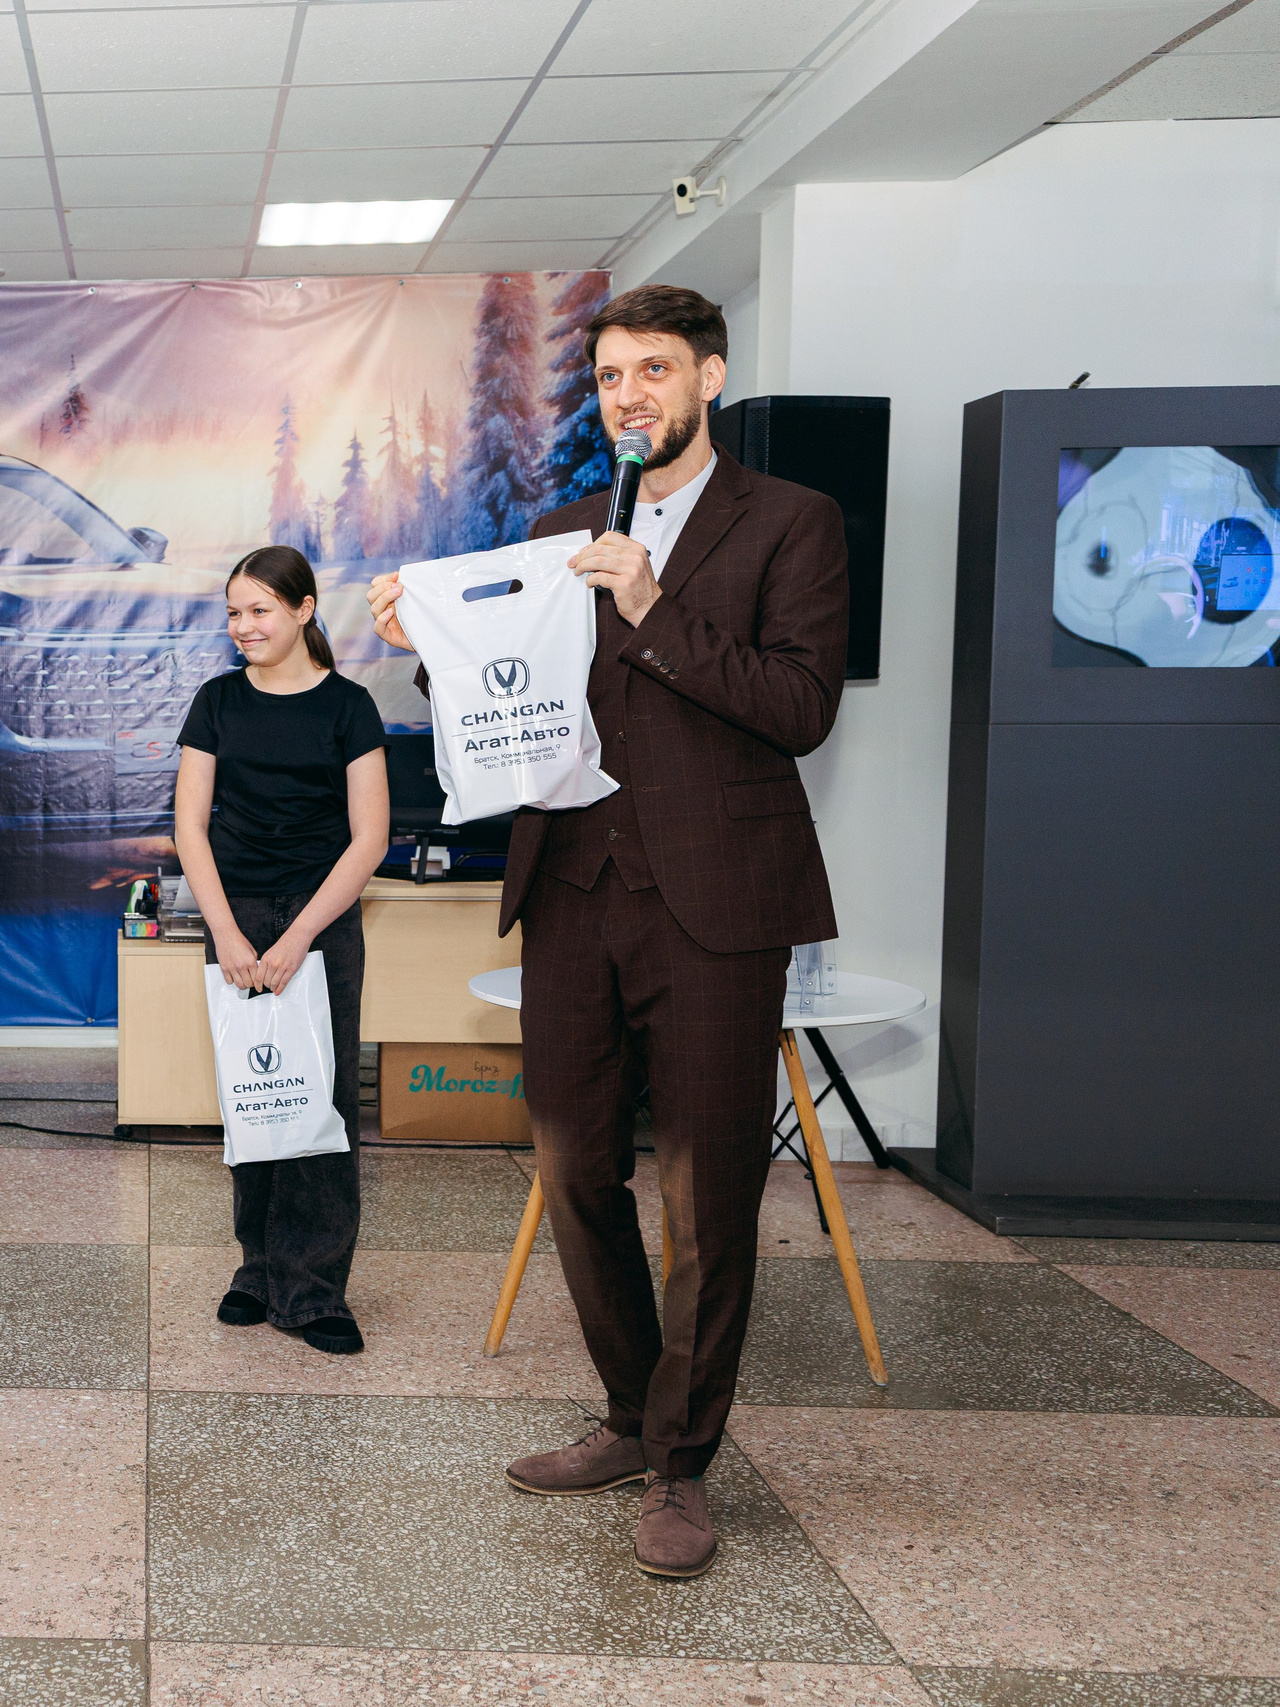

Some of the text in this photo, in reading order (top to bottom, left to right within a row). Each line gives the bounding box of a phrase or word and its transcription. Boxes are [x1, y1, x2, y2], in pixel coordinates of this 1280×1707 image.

[461, 700, 564, 726] CHANGAN
[464, 726, 570, 753] Агат-Авто
[474, 755, 500, 765] Братск,
[500, 760, 506, 768] 8
[528, 755, 541, 764] 350
[543, 752, 557, 761] 555
[233, 1077, 304, 1093] CHANGAN
[235, 1097, 308, 1113] Агат-Авто
